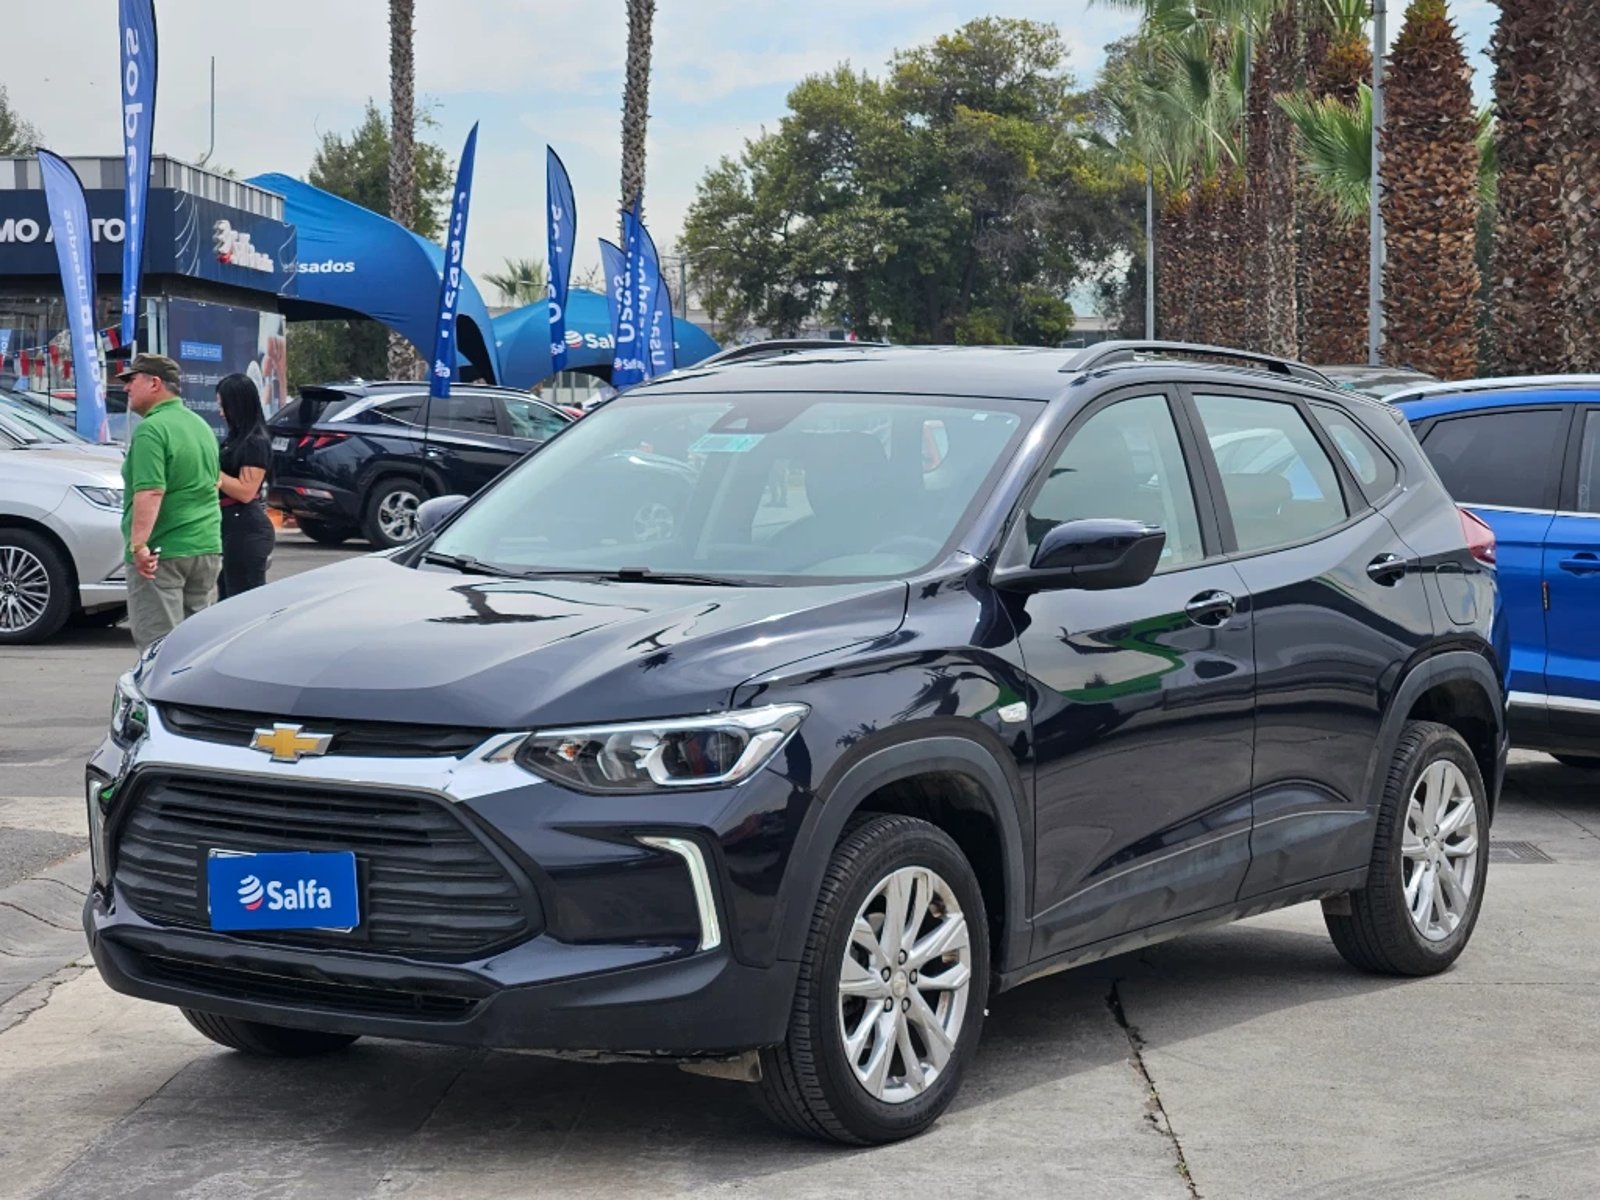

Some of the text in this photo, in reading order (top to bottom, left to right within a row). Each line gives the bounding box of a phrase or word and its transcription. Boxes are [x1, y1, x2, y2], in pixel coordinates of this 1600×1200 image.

[297, 259, 355, 273] sados
[584, 333, 615, 349] Sal
[267, 879, 332, 910] Salfa
